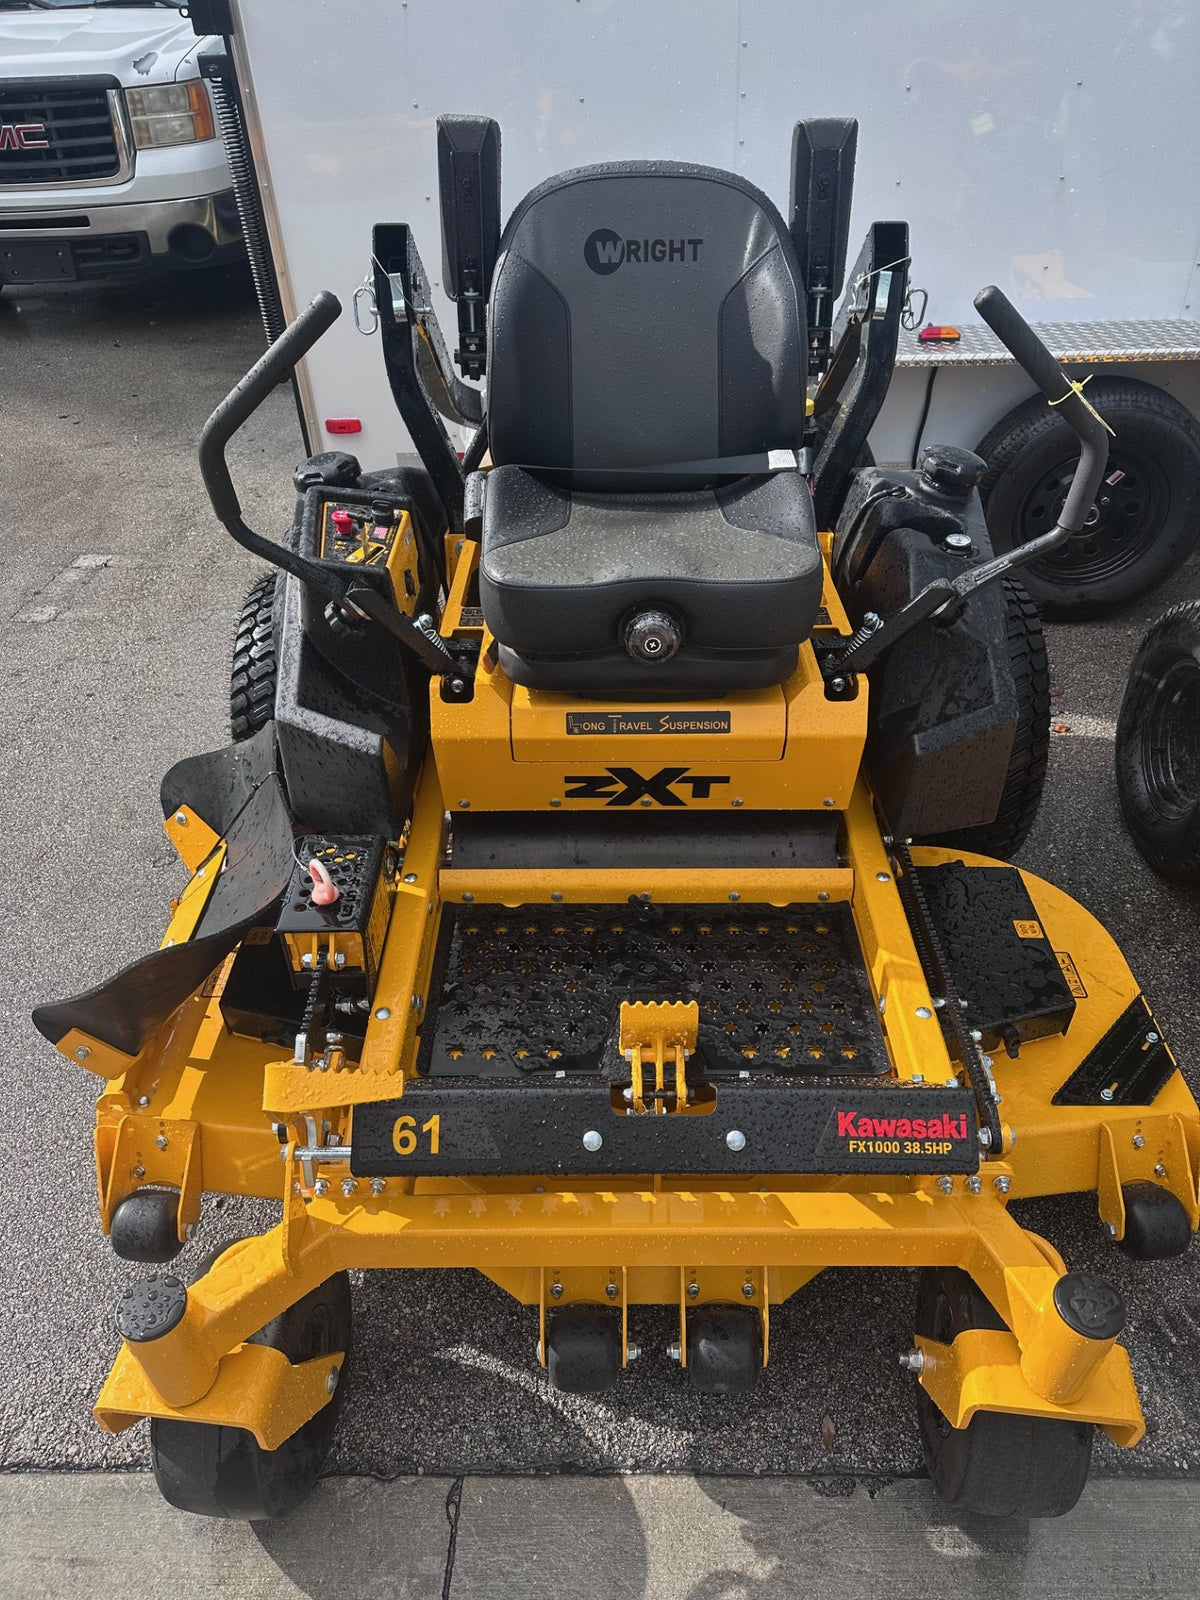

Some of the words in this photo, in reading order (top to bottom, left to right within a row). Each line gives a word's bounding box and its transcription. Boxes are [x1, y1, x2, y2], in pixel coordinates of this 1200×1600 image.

[593, 237, 704, 265] WRIGHT
[608, 714, 653, 733] TRAVEL
[659, 714, 728, 732] SUSPENSION
[564, 767, 731, 806] ZXT
[392, 1114, 440, 1155] 61
[837, 1111, 968, 1139] Kawasaki
[849, 1140, 900, 1153] FX1000
[903, 1141, 953, 1155] 38.5HP
